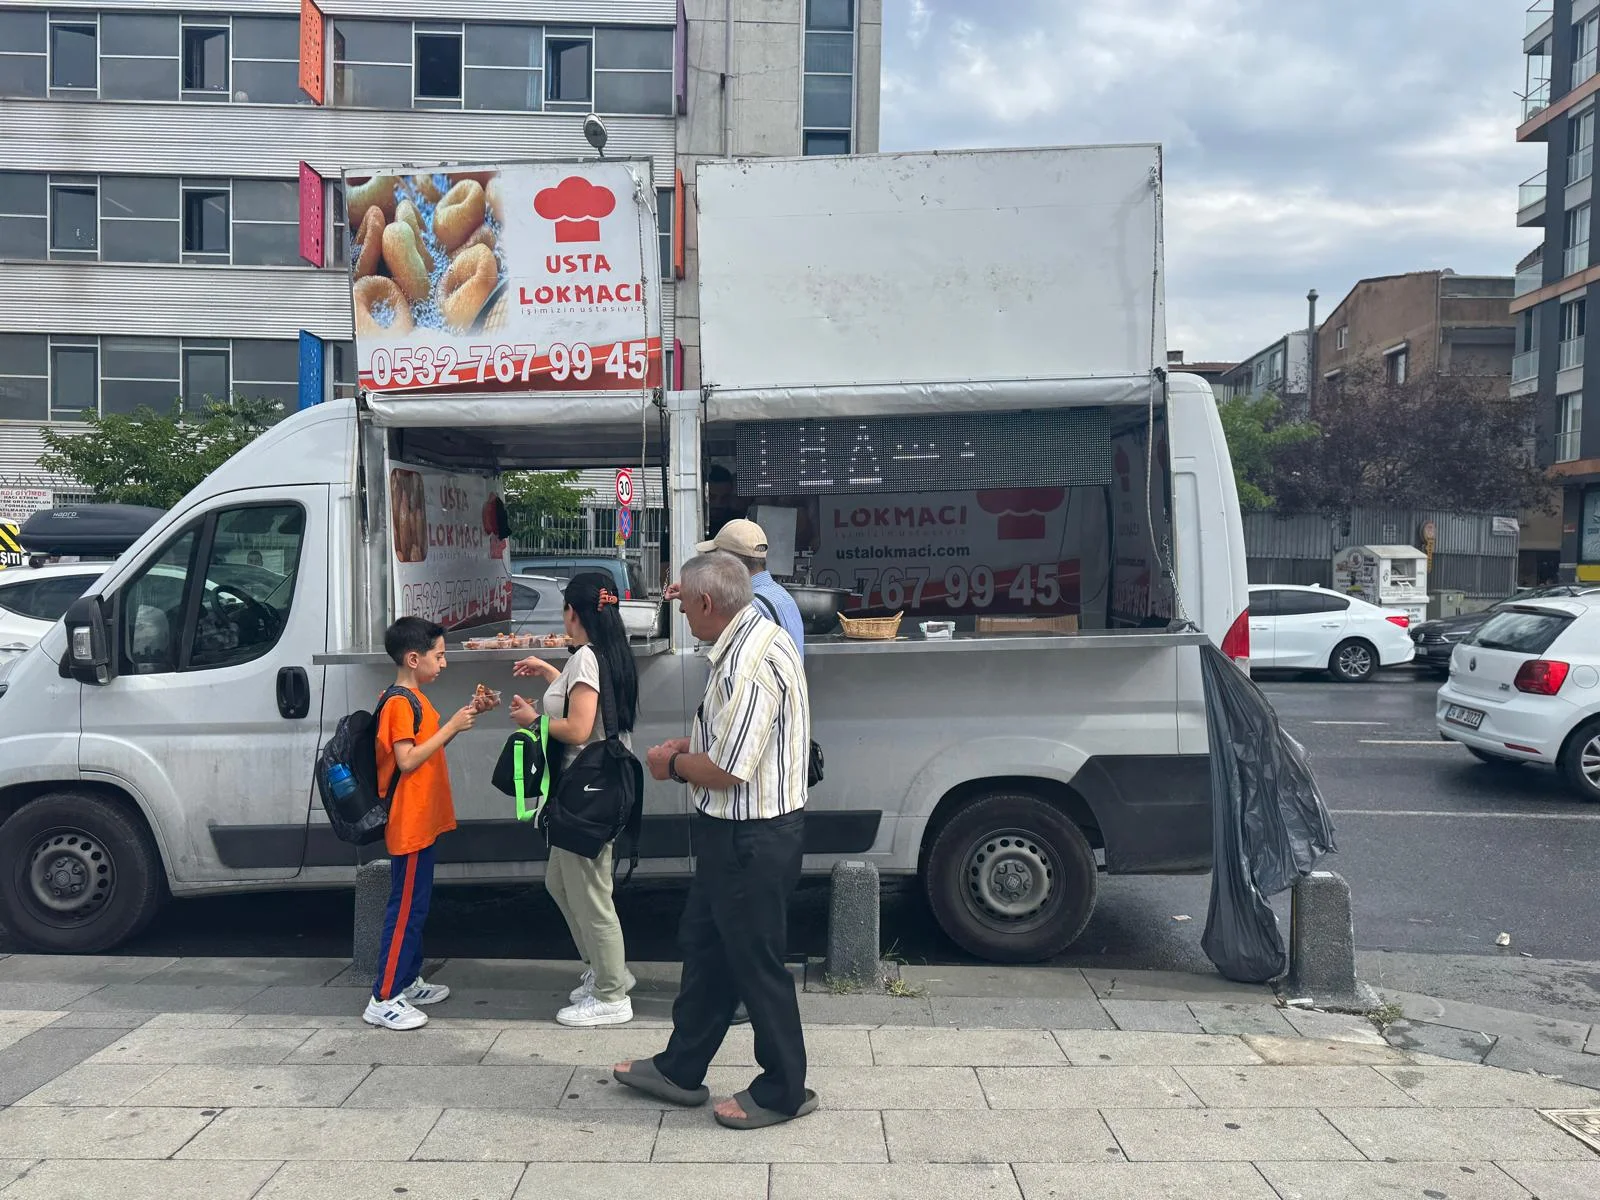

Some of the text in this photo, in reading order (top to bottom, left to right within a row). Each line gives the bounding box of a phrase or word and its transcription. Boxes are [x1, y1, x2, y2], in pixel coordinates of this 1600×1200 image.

[545, 254, 612, 274] USTA
[519, 283, 642, 305] LOKMACI
[371, 341, 647, 386] 0532 767 99 45
[619, 480, 630, 496] 30
[833, 505, 968, 529] LOKMACI
[836, 544, 970, 560] ustalokmaci.com
[854, 566, 930, 609] 767
[944, 565, 995, 608] 99
[1008, 563, 1061, 607] 45
